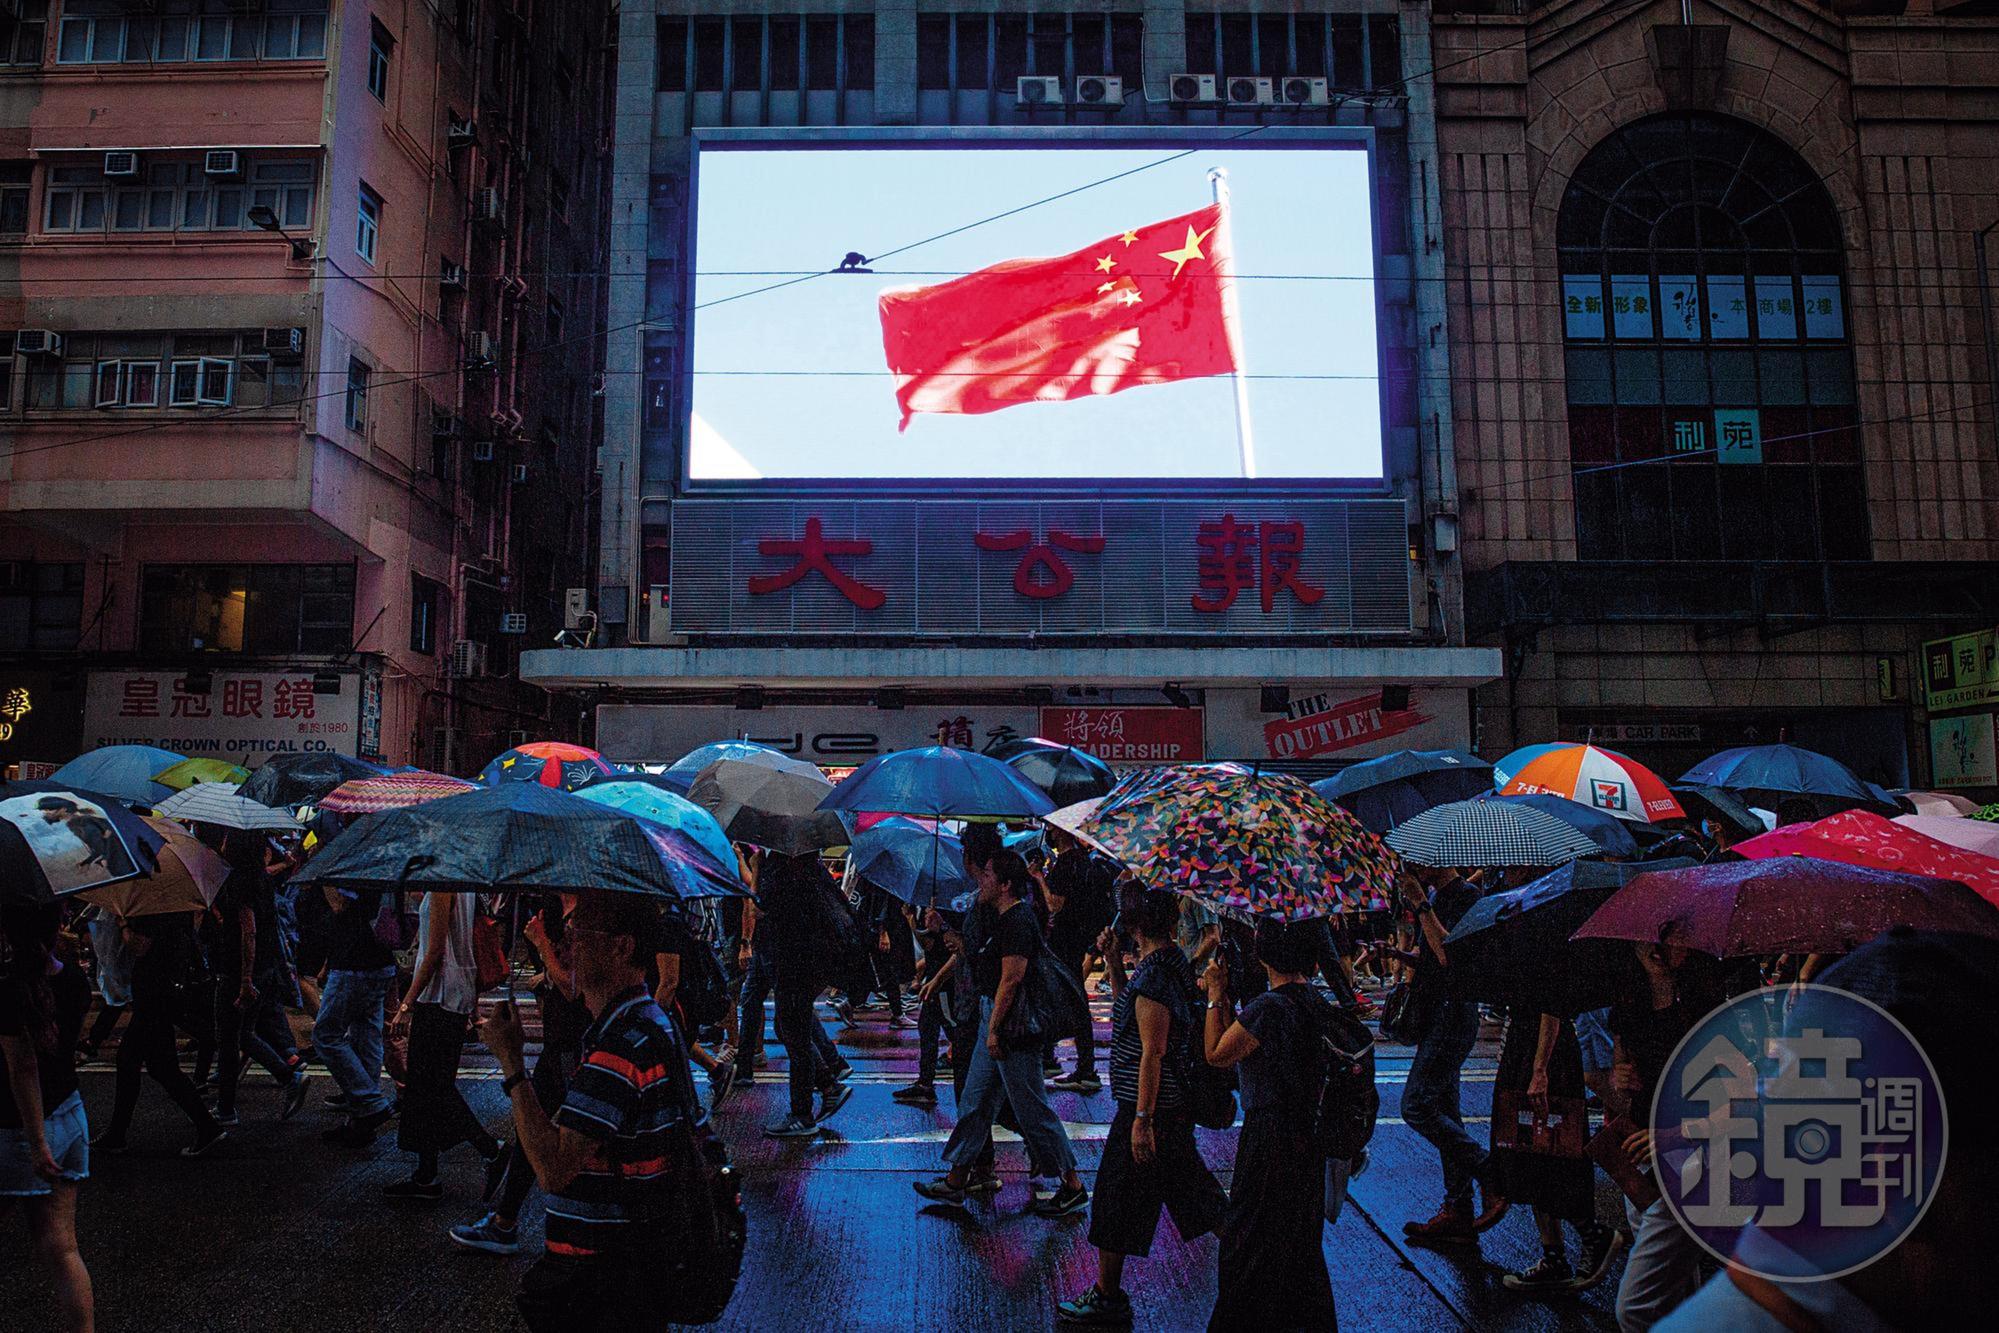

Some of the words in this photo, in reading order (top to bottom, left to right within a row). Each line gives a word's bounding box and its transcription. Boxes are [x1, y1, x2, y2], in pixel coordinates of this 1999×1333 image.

[1567, 295, 1649, 314] 全新形象
[1730, 297, 1833, 316] 本商場2樓
[1674, 420, 1754, 451] 利苑
[748, 513, 1325, 611] 大公報
[1932, 648, 1974, 681] 利苑
[119, 677, 316, 719] 皇冠眼鏡
[1284, 693, 1331, 721] THE
[160, 739, 219, 751] CROWN
[226, 739, 298, 752] OPTICAL
[1274, 706, 1383, 758] OUTLET
